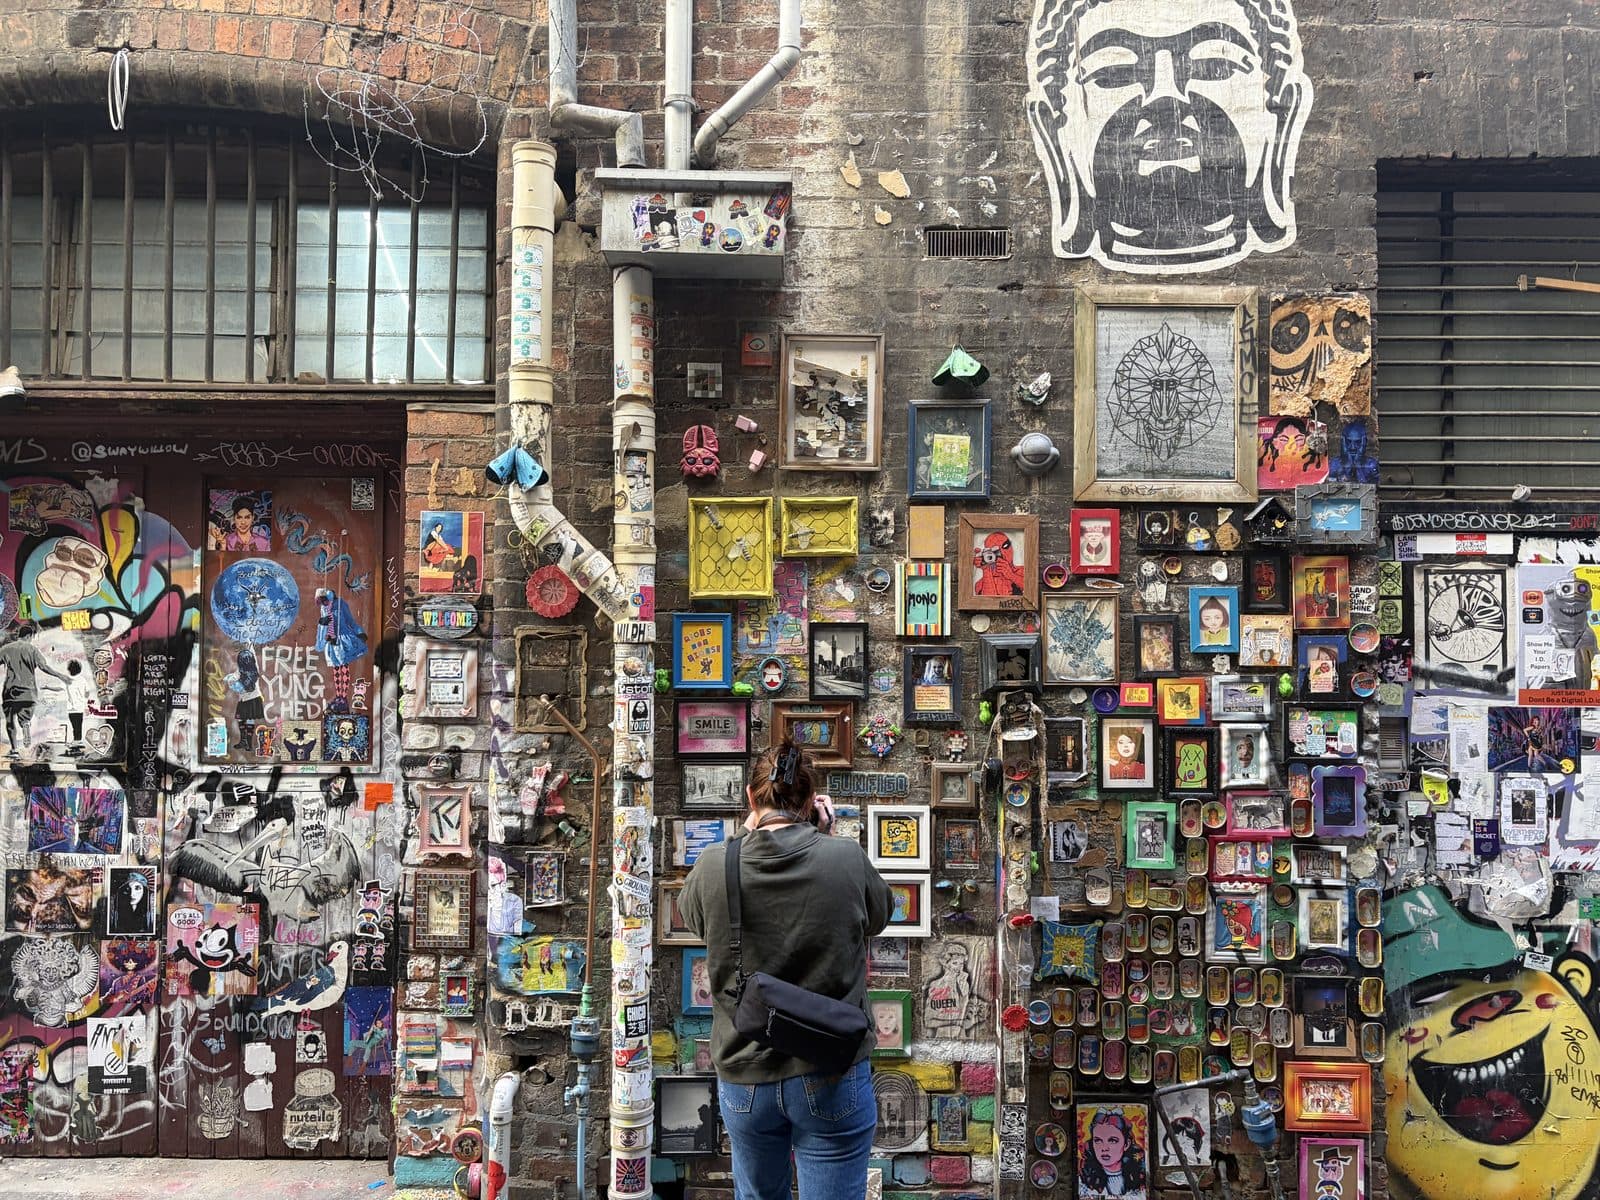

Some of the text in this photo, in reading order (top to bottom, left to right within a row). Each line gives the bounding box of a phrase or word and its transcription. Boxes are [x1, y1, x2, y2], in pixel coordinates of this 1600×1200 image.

[907, 592, 938, 606] MONO
[1461, 586, 1505, 630] KAPOW
[423, 611, 473, 627] WELCOME
[262, 645, 320, 673] FREE
[261, 672, 326, 701] YUNG
[695, 719, 731, 730] SMILE
[930, 998, 957, 1010] QUEEN
[289, 1110, 335, 1122] nutella
